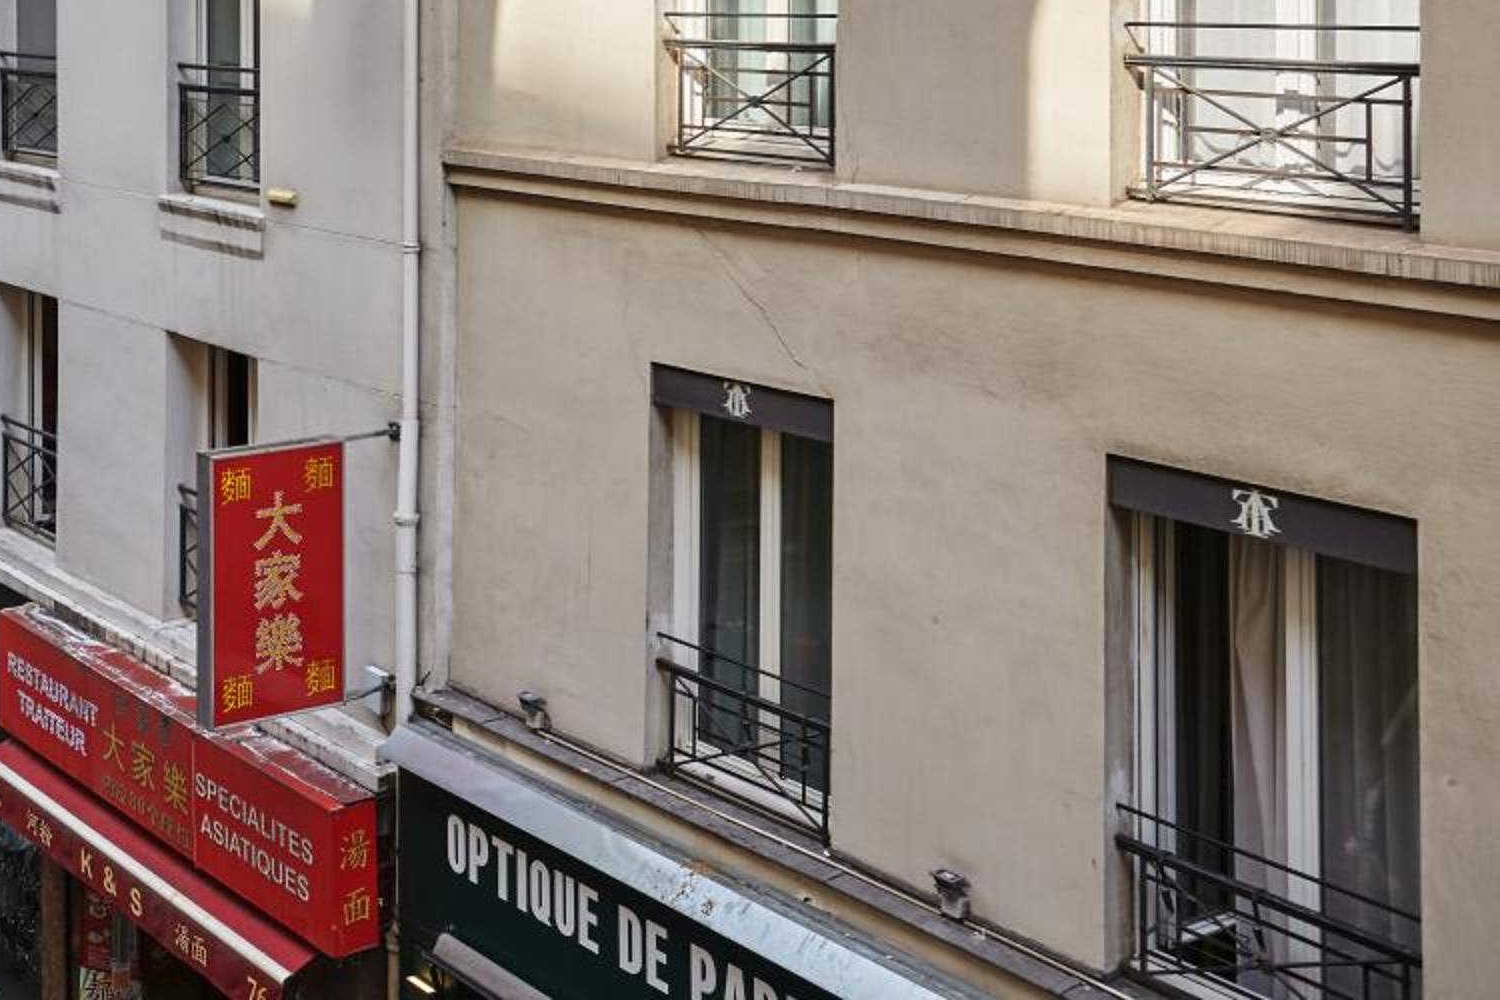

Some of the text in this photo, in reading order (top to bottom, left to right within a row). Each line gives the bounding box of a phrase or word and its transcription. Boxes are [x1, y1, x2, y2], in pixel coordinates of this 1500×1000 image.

[253, 490, 304, 676] 大家樂
[7, 651, 99, 728] RESTAURANT
[17, 689, 88, 757] TRAITEUR
[101, 720, 190, 817] 大家樂
[195, 772, 314, 866] SPECIALITES
[201, 813, 309, 902] ASIATIQUES
[81, 847, 142, 918] K & S
[447, 813, 600, 955] OPTIQUE
[617, 903, 669, 996] DE
